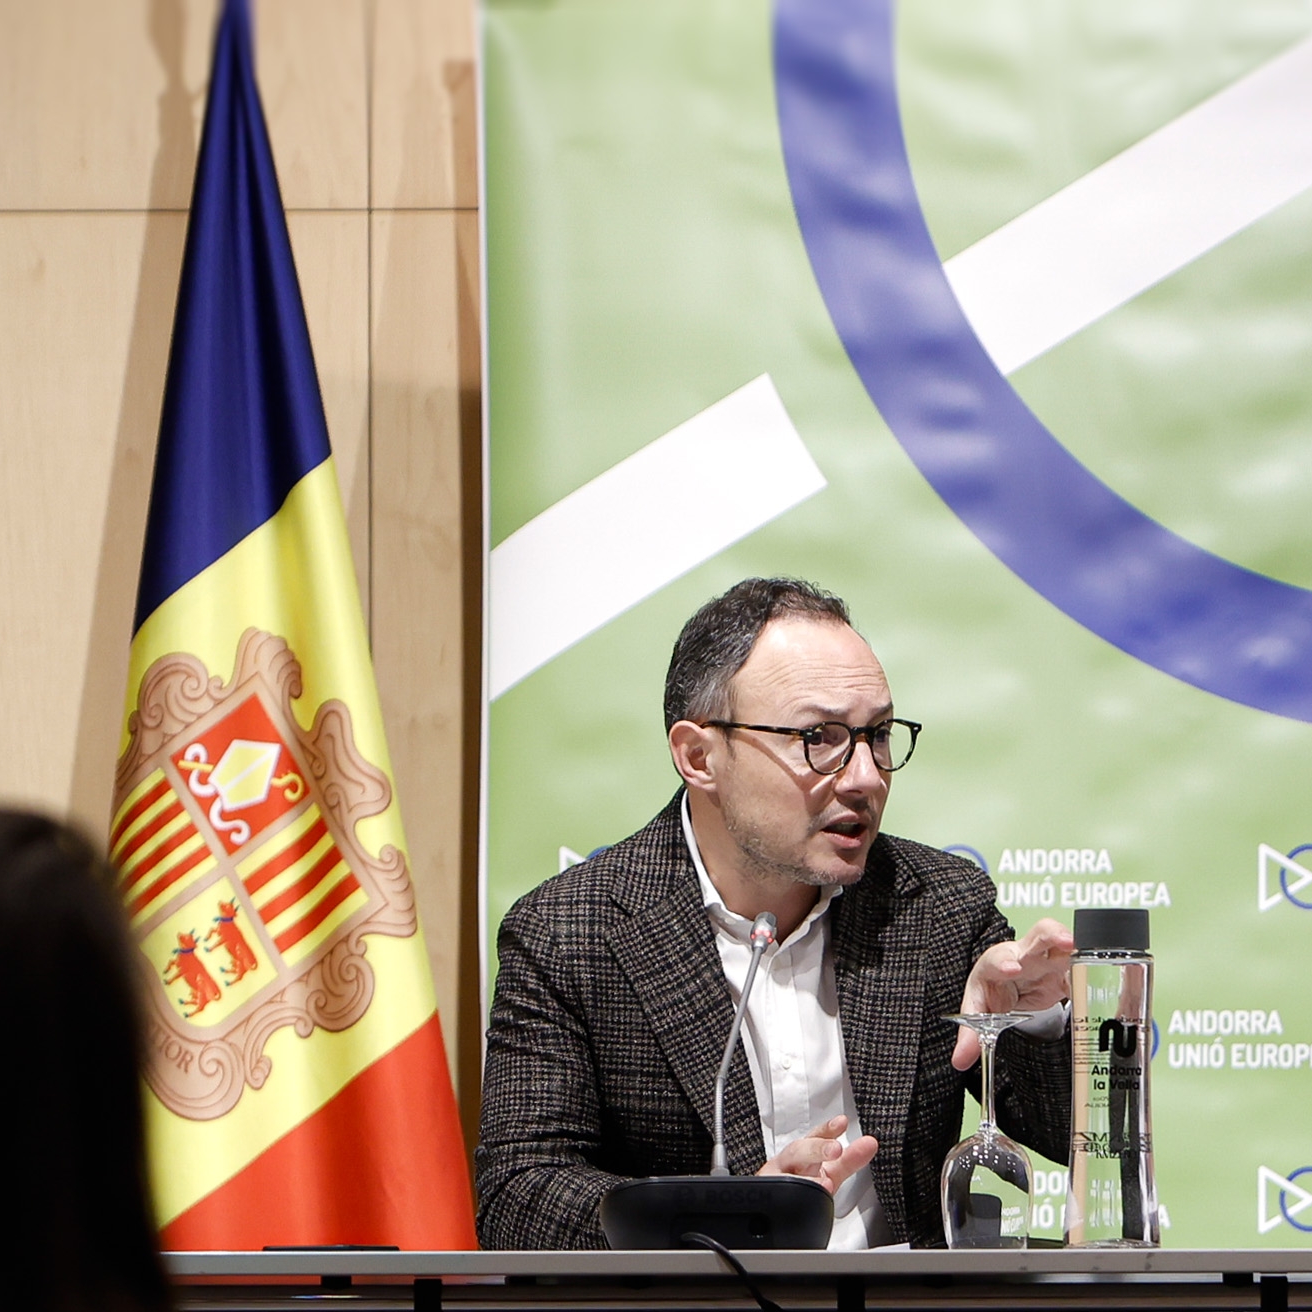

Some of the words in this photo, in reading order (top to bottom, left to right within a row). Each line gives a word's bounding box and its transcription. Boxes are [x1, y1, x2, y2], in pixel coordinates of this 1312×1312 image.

[997, 848, 1113, 874] ANDORRA
[998, 876, 1056, 907] UNIÓ
[1060, 881, 1172, 908] EUROPEA
[1168, 1010, 1283, 1035] ANDORRA
[1168, 1037, 1226, 1068] UNIÓ
[1091, 1065, 1142, 1076] Andorra
[1093, 1079, 1105, 1090] la
